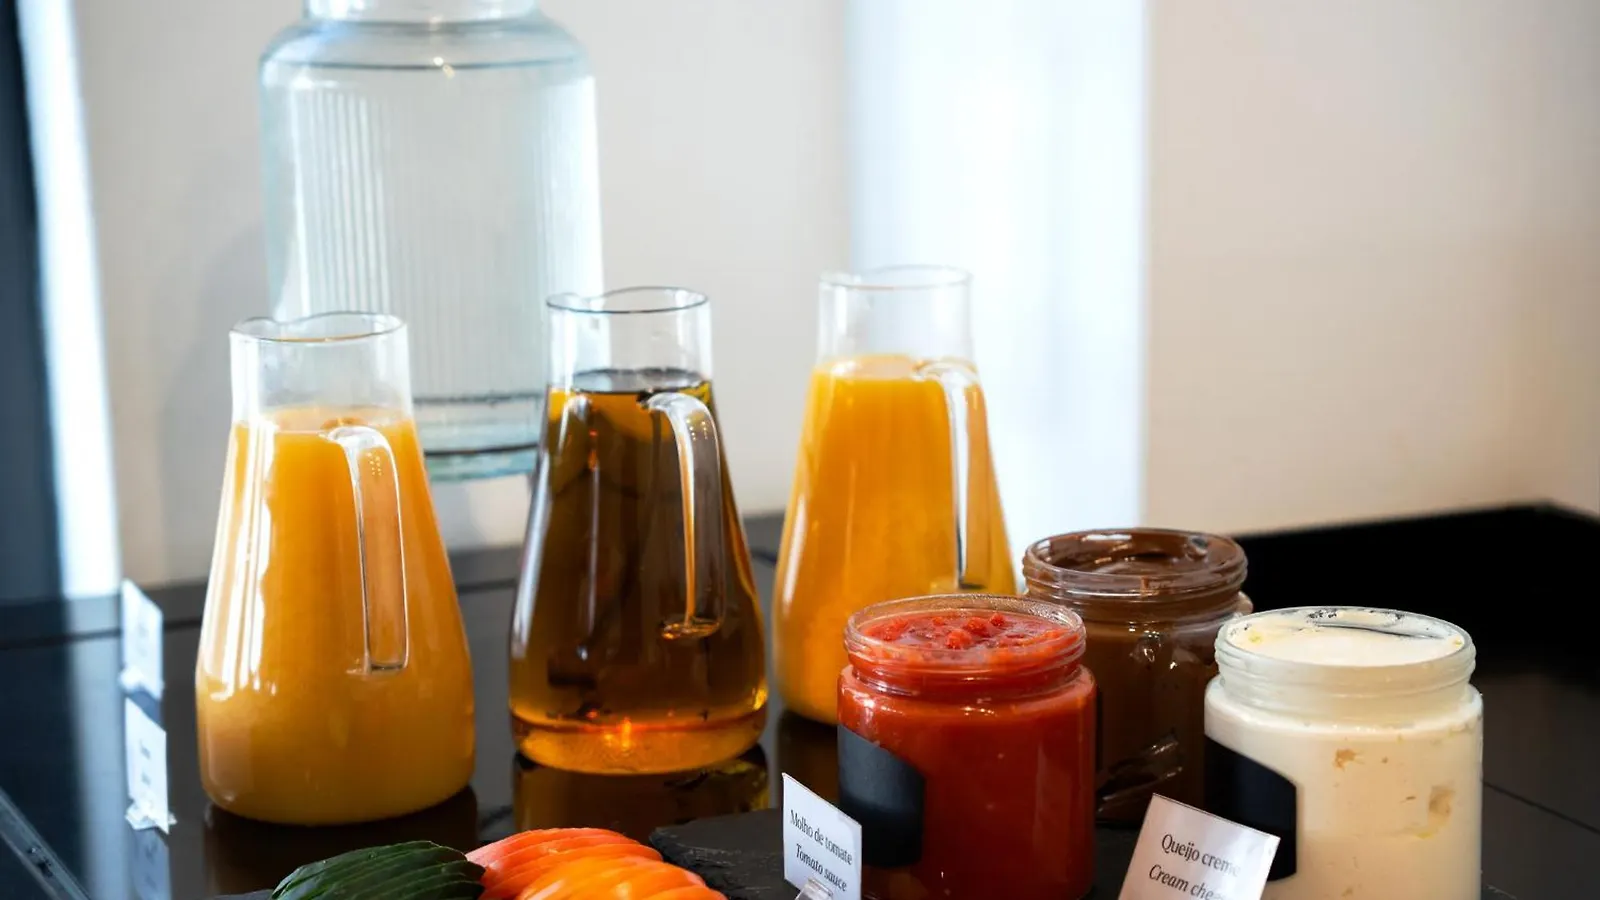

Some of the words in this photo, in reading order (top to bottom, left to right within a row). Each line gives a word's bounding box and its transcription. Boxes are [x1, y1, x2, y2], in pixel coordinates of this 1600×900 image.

[790, 809, 813, 837] Molho
[814, 827, 824, 846] de
[825, 836, 852, 866] tomate
[1161, 834, 1200, 862] Queijo
[796, 843, 823, 875] Tomato
[824, 867, 847, 892] sauce
[1149, 864, 1189, 892] Cream
